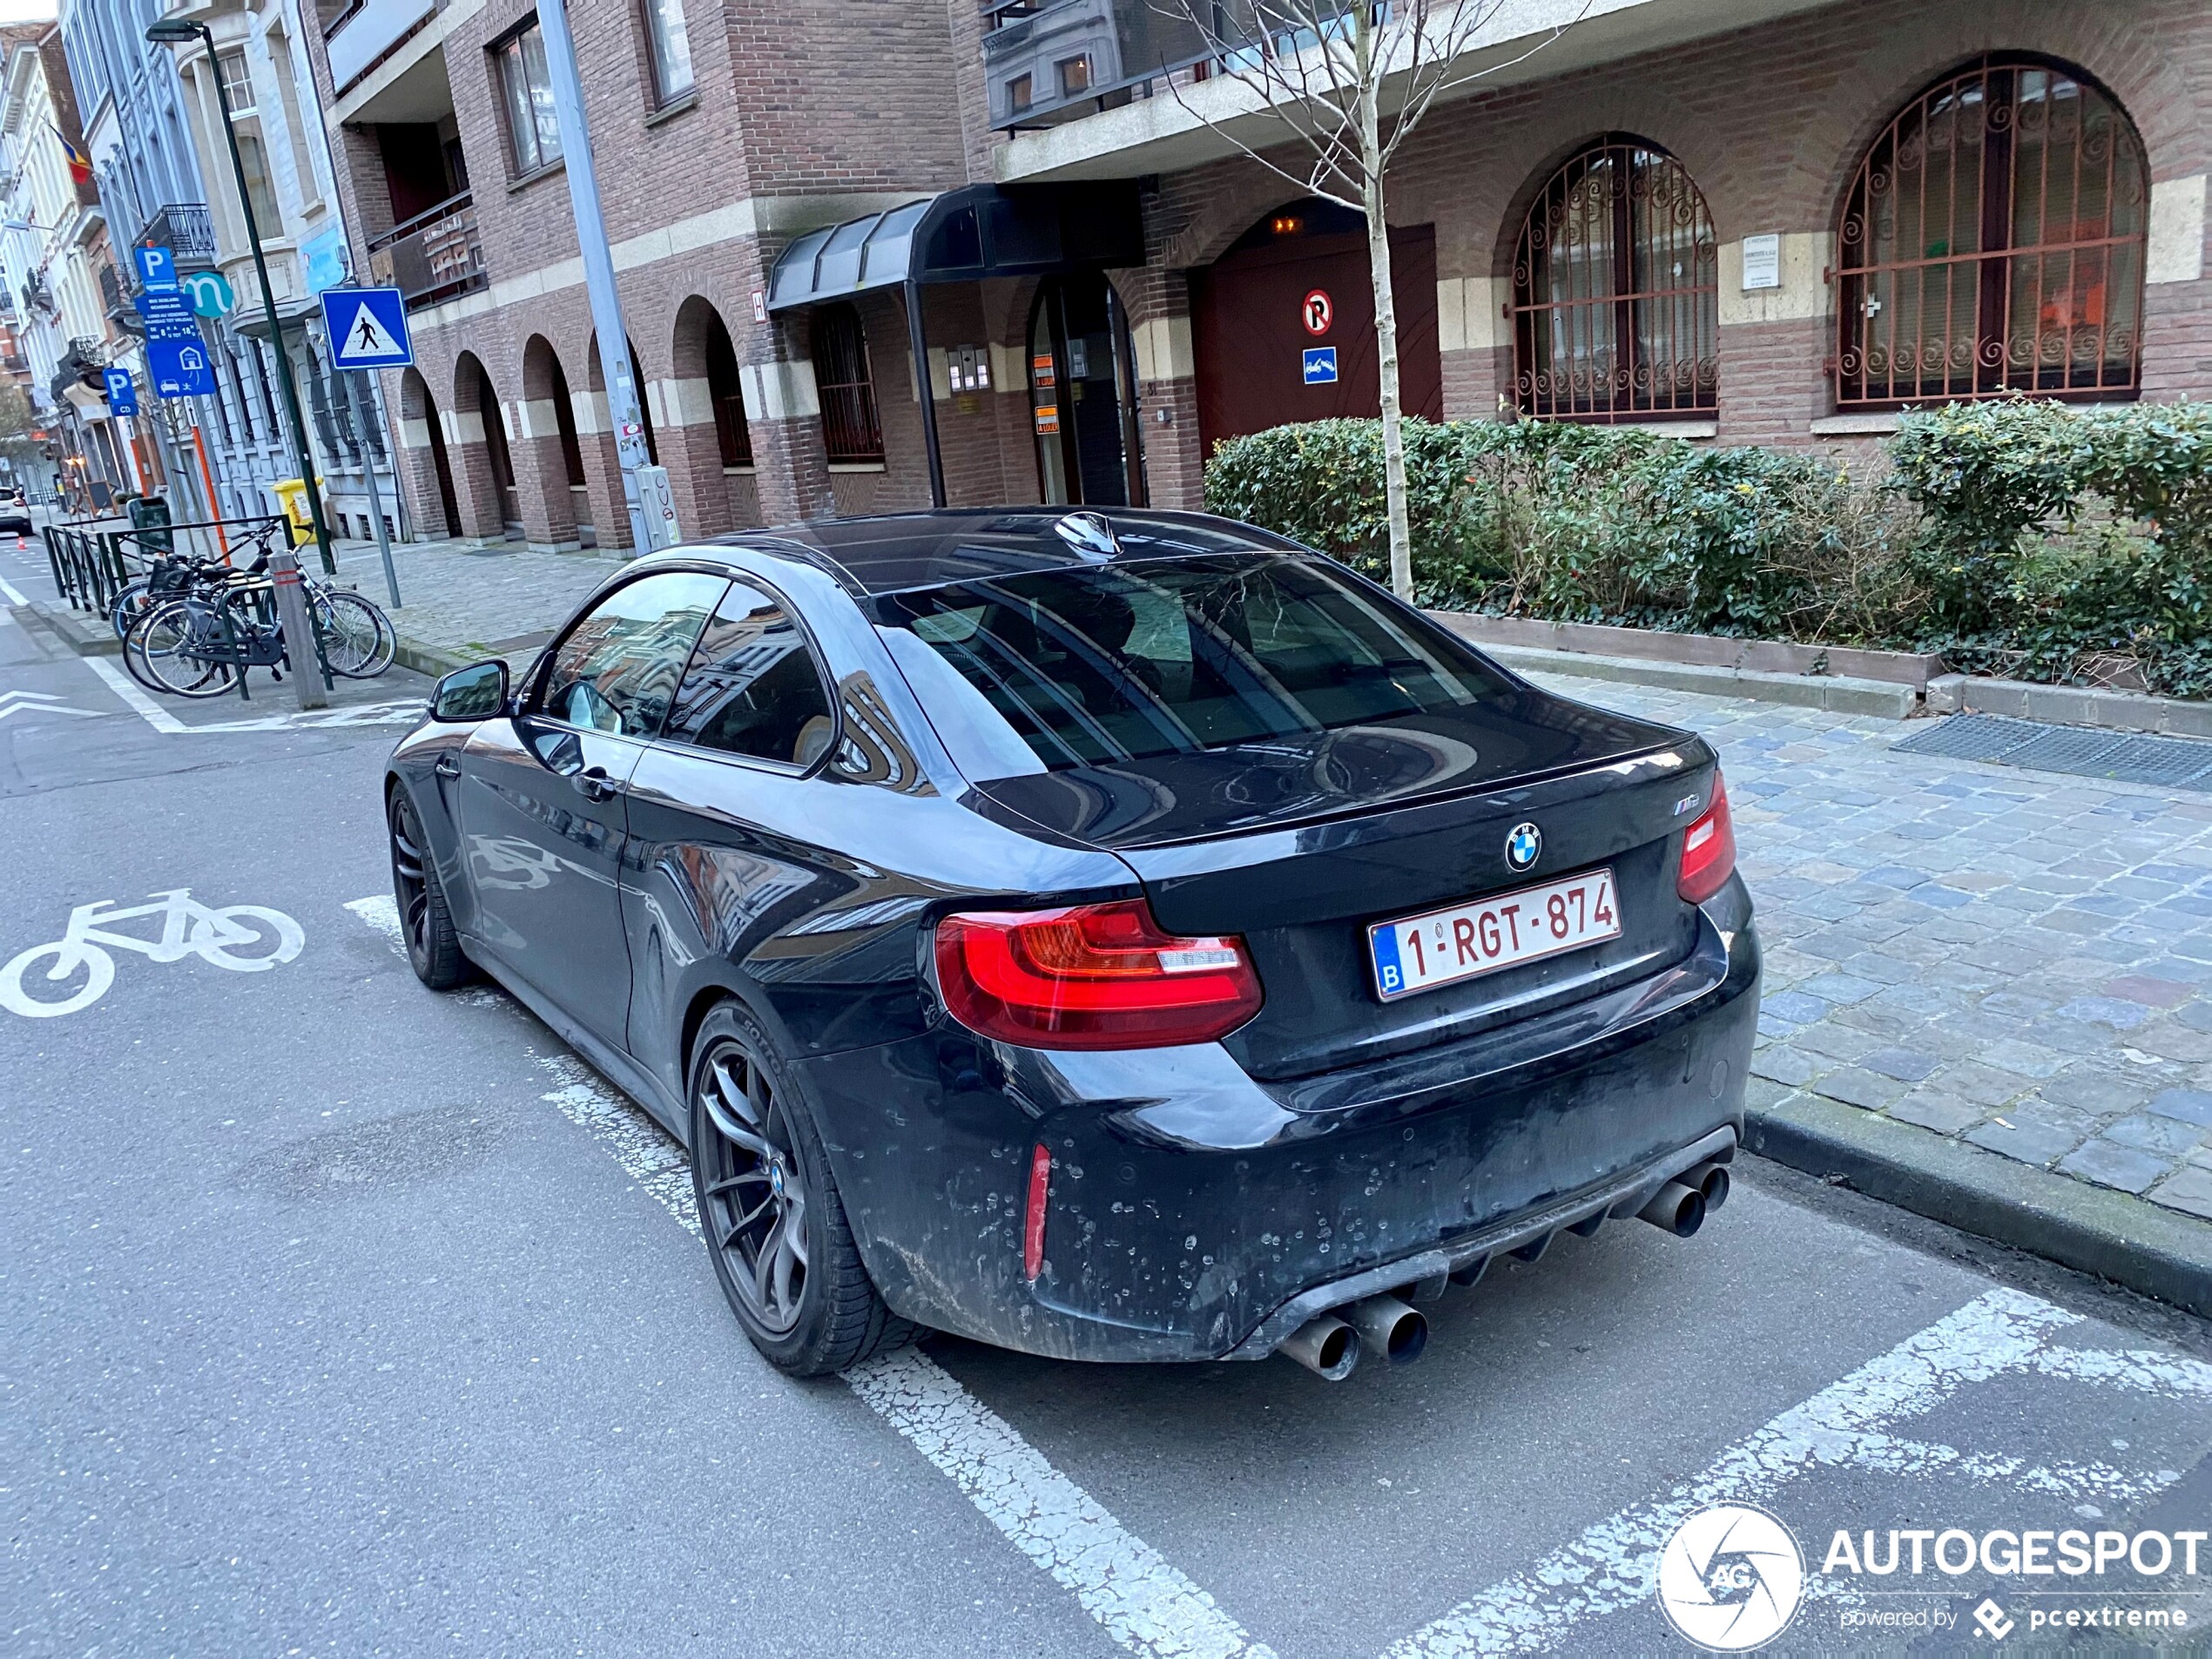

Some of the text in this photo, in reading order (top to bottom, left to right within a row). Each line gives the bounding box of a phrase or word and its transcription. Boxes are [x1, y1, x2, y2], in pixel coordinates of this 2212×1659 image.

[144, 252, 164, 277] P
[181, 327, 192, 335] 18
[107, 374, 128, 400] P
[1509, 826, 1540, 843] BMW
[1383, 964, 1399, 988] B
